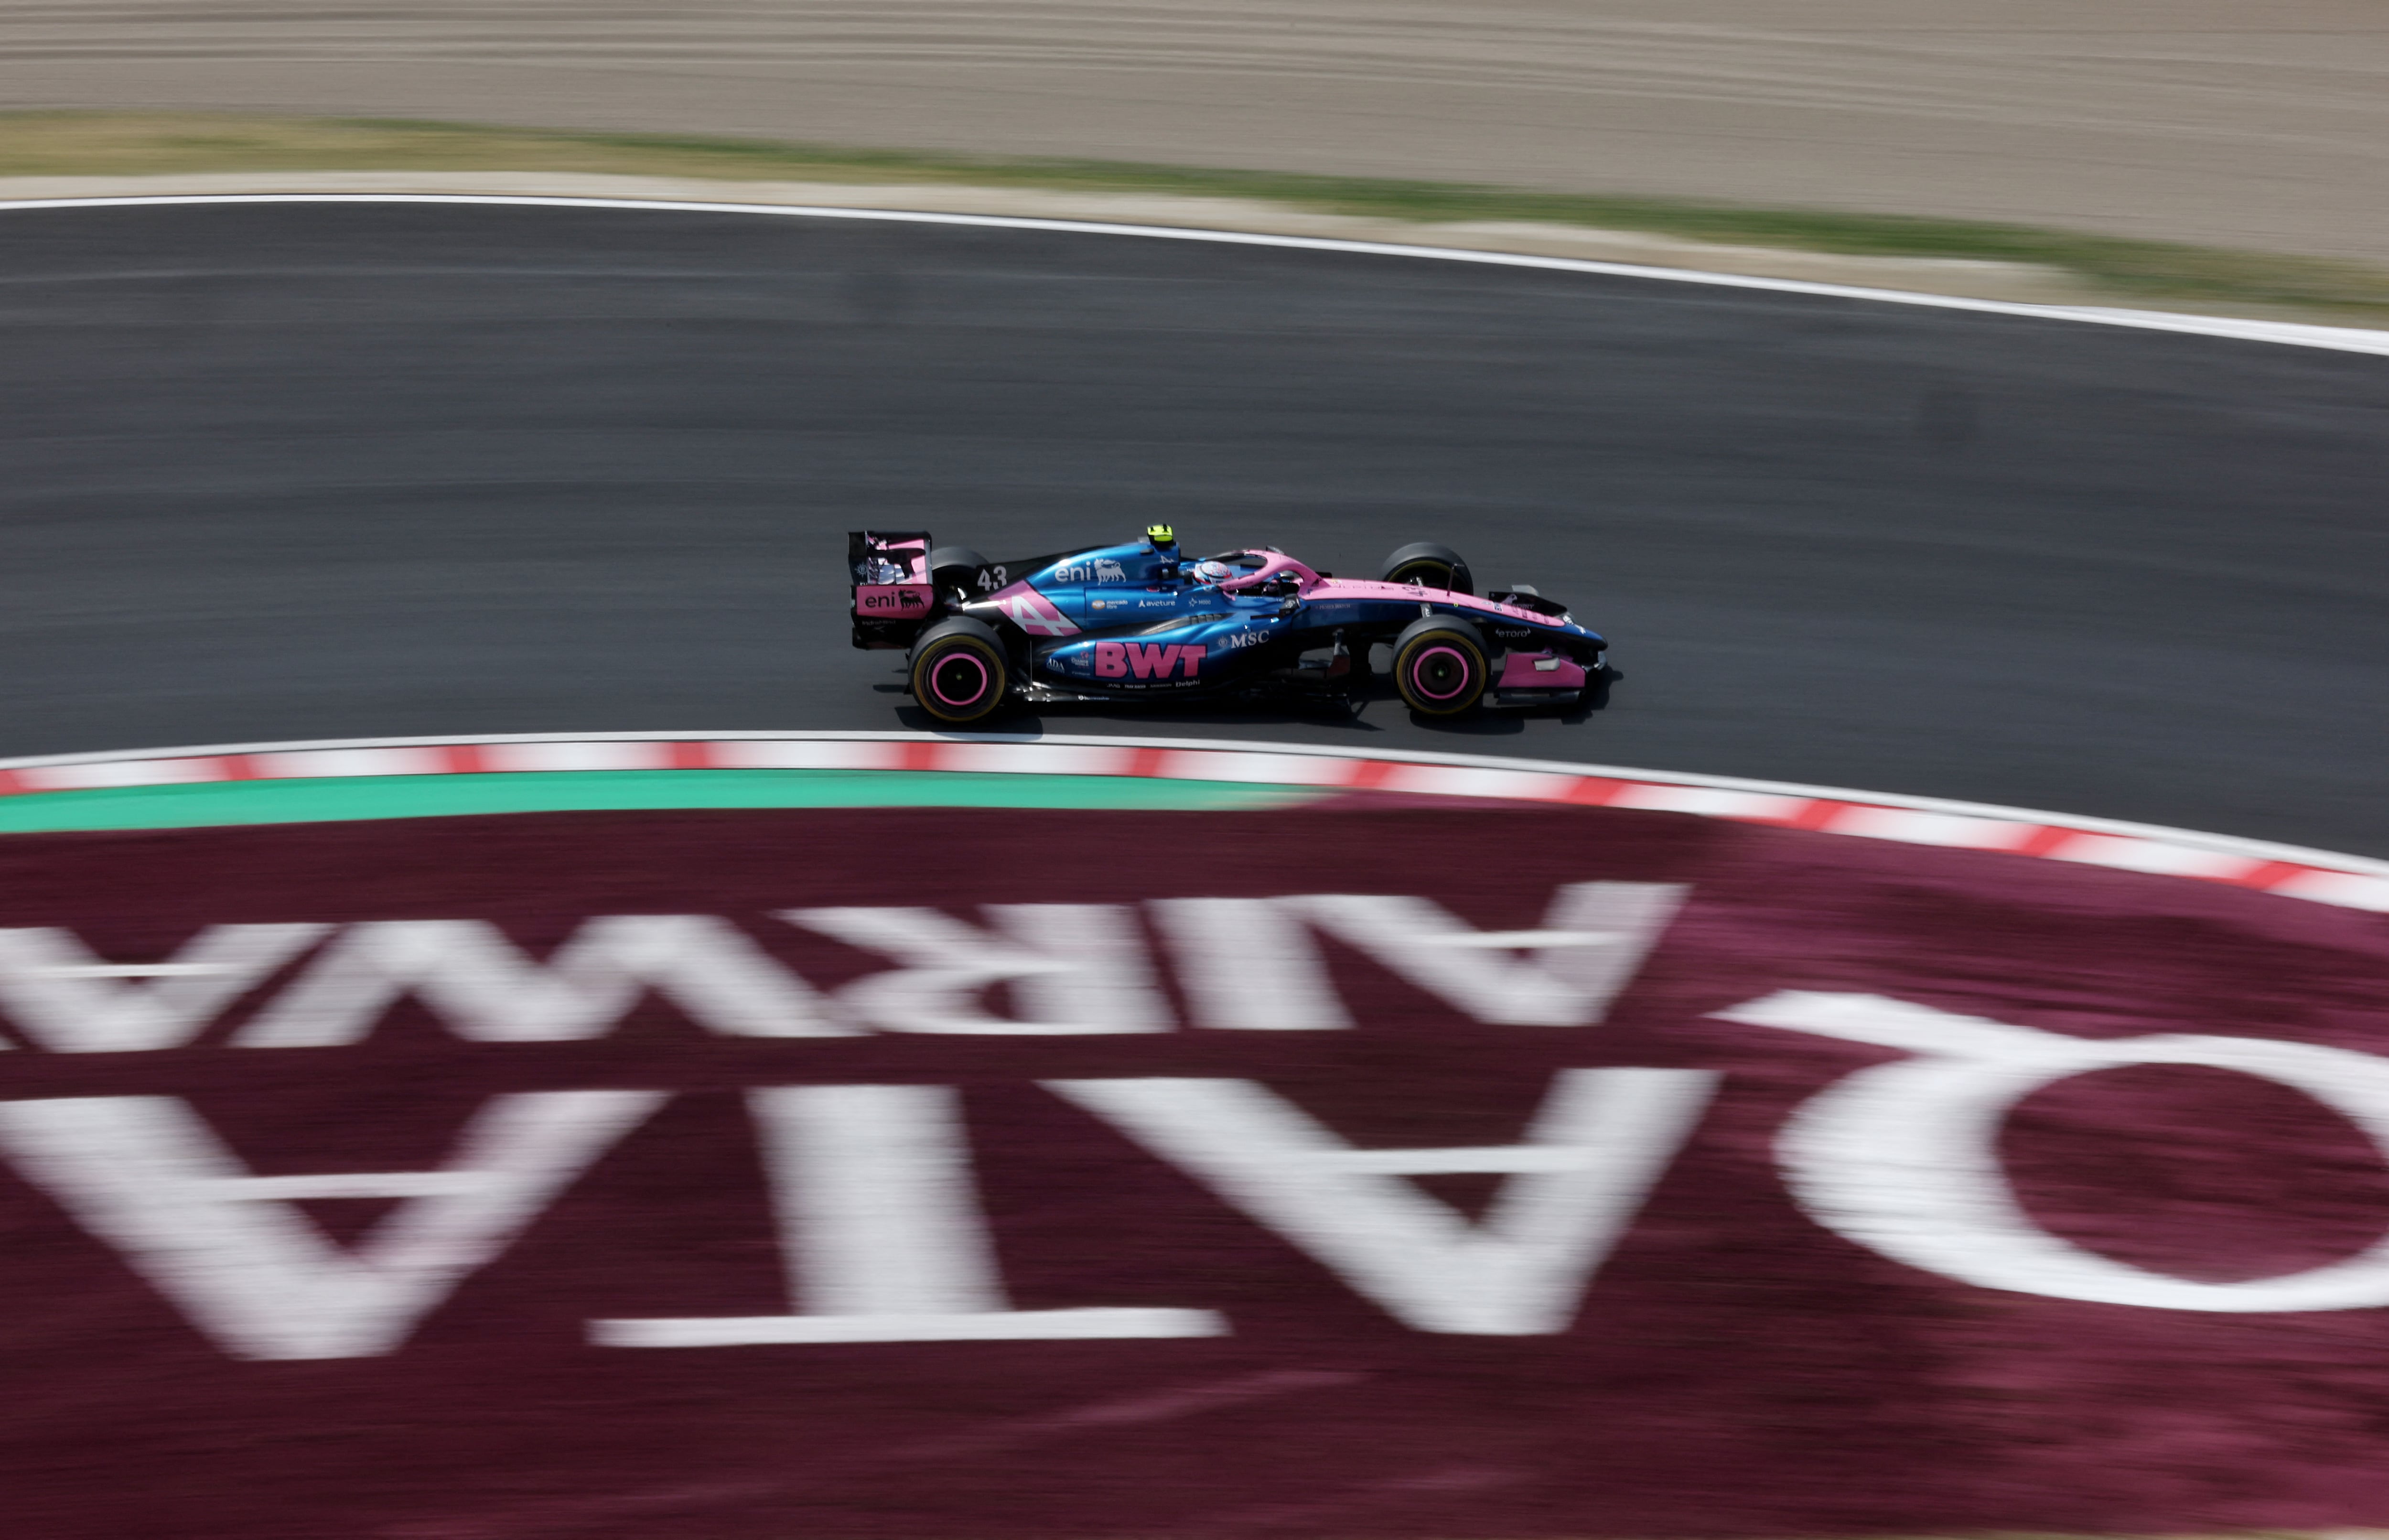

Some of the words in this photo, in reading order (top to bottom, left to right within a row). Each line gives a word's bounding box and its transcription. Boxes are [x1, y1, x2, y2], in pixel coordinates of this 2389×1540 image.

[978, 566, 1007, 591] 43
[1055, 562, 1090, 582] eni
[865, 592, 895, 608] eni
[1231, 631, 1269, 648] MSC
[1096, 642, 1207, 678] BWT
[1175, 679, 1200, 688] Delphi
[0, 882, 1694, 1054] AIRWA
